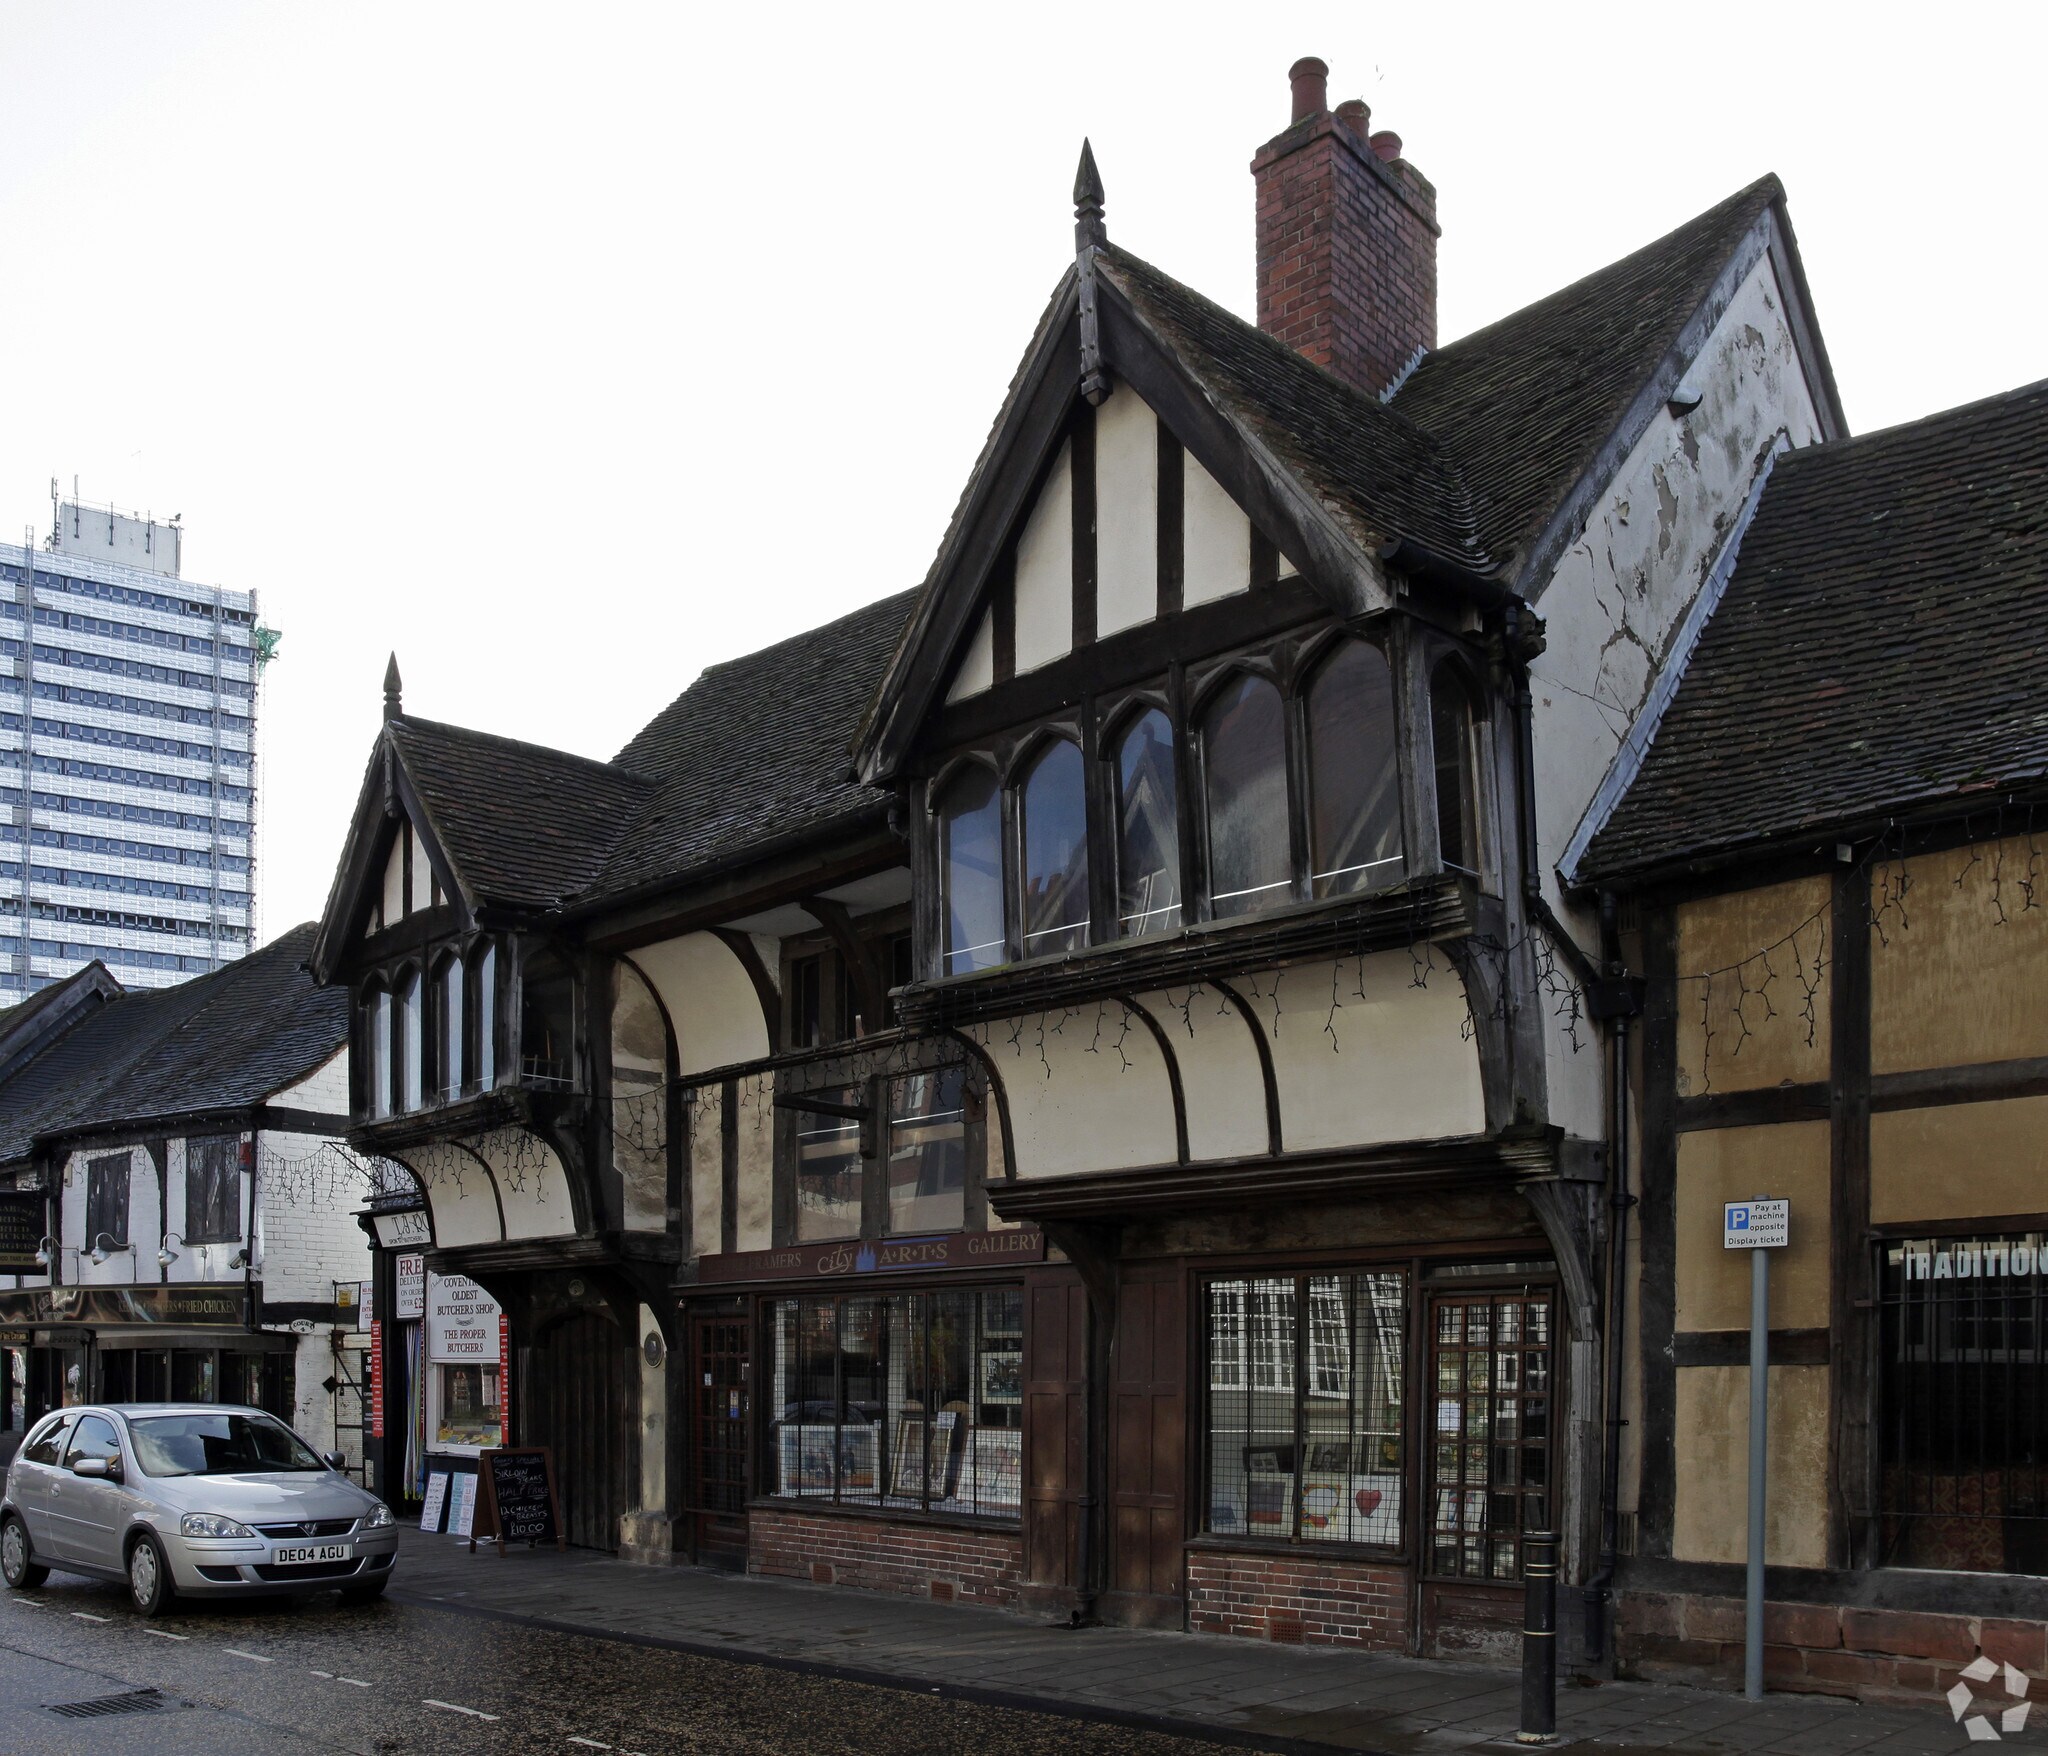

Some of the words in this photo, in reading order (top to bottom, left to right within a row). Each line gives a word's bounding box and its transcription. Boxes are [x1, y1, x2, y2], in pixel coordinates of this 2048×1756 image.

[1755, 1204, 1769, 1212] Pay
[1750, 1212, 1785, 1220] machine
[1750, 1223, 1785, 1231] opposite
[1728, 1237, 1758, 1245] Display
[817, 1245, 854, 1275] City
[967, 1234, 1041, 1255] GALLERY
[399, 1258, 424, 1277] FRE
[452, 1289, 478, 1301] OLDEST
[182, 1299, 203, 1313] FRIED
[204, 1299, 236, 1313] CHICKEN
[437, 1304, 474, 1316] BUTCHERS
[475, 1303, 495, 1315] SHOP
[293, 1320, 315, 1330] COURT
[444, 1329, 458, 1340] THE
[460, 1328, 487, 1340] PROPER
[447, 1342, 484, 1353] BUTCHERS
[494, 1468, 529, 1480] SIRLOIN
[497, 1484, 526, 1500] HALF
[527, 1483, 550, 1495] PRICE
[510, 1503, 544, 1514] CHICKEN
[516, 1510, 548, 1520] BREASTS
[279, 1547, 316, 1562] DE04
[319, 1546, 344, 1560] AGU
